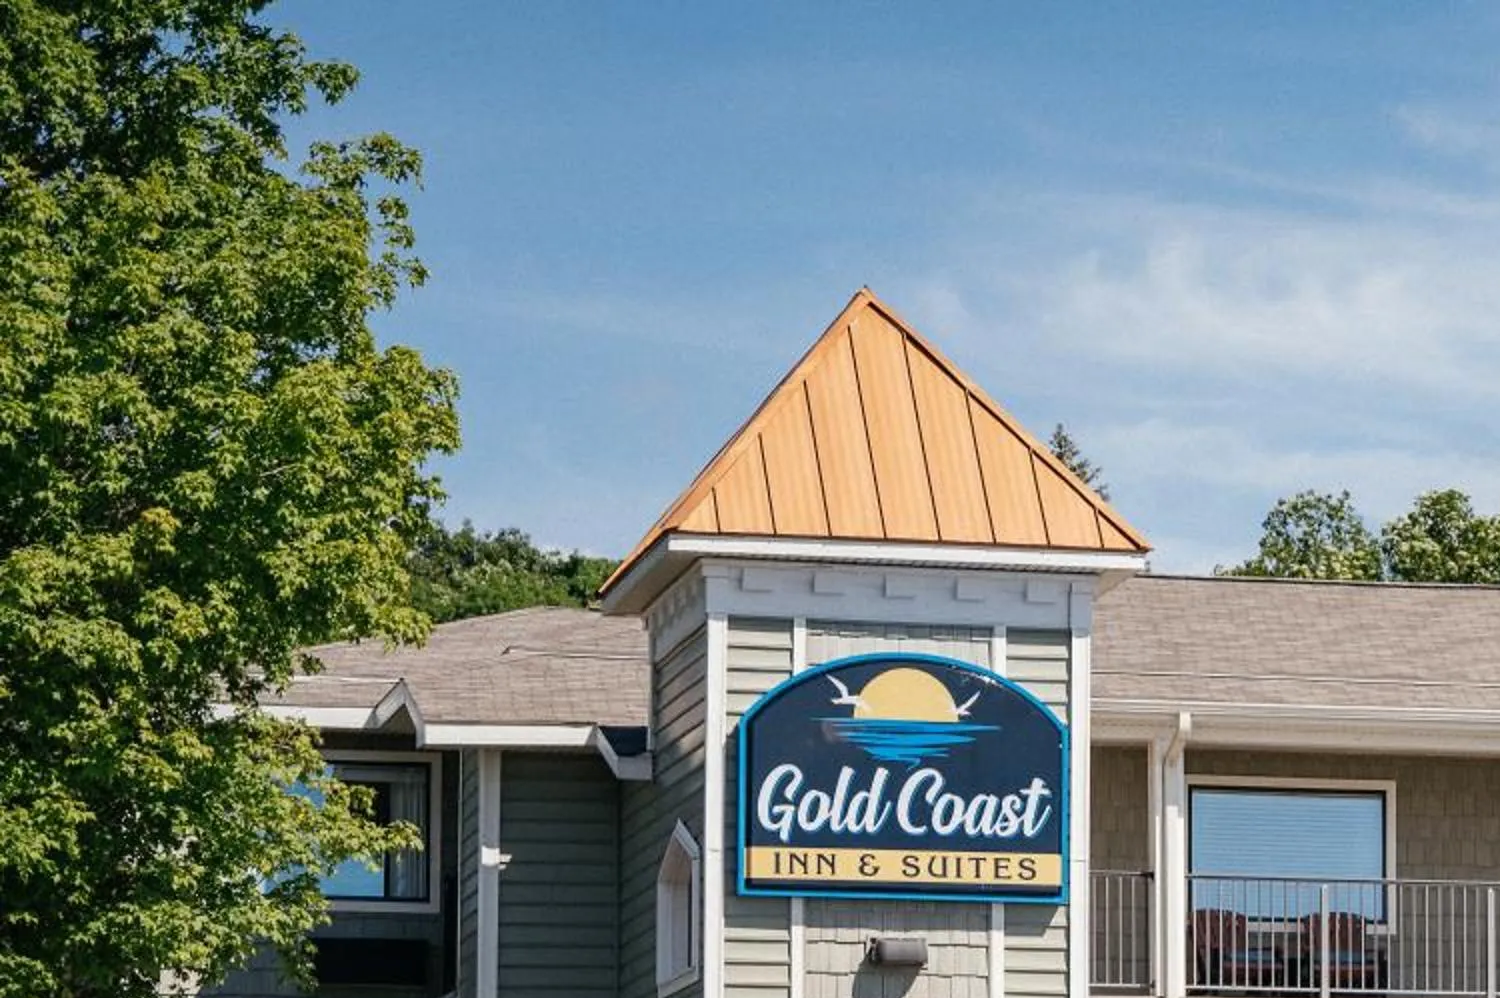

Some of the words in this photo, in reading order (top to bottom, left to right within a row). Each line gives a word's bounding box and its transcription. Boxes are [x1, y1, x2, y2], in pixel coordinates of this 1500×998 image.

[757, 763, 891, 842] Gold
[897, 767, 1053, 838] Coast
[773, 852, 837, 876] INN
[858, 853, 881, 877] &
[901, 856, 1039, 881] SUITES
